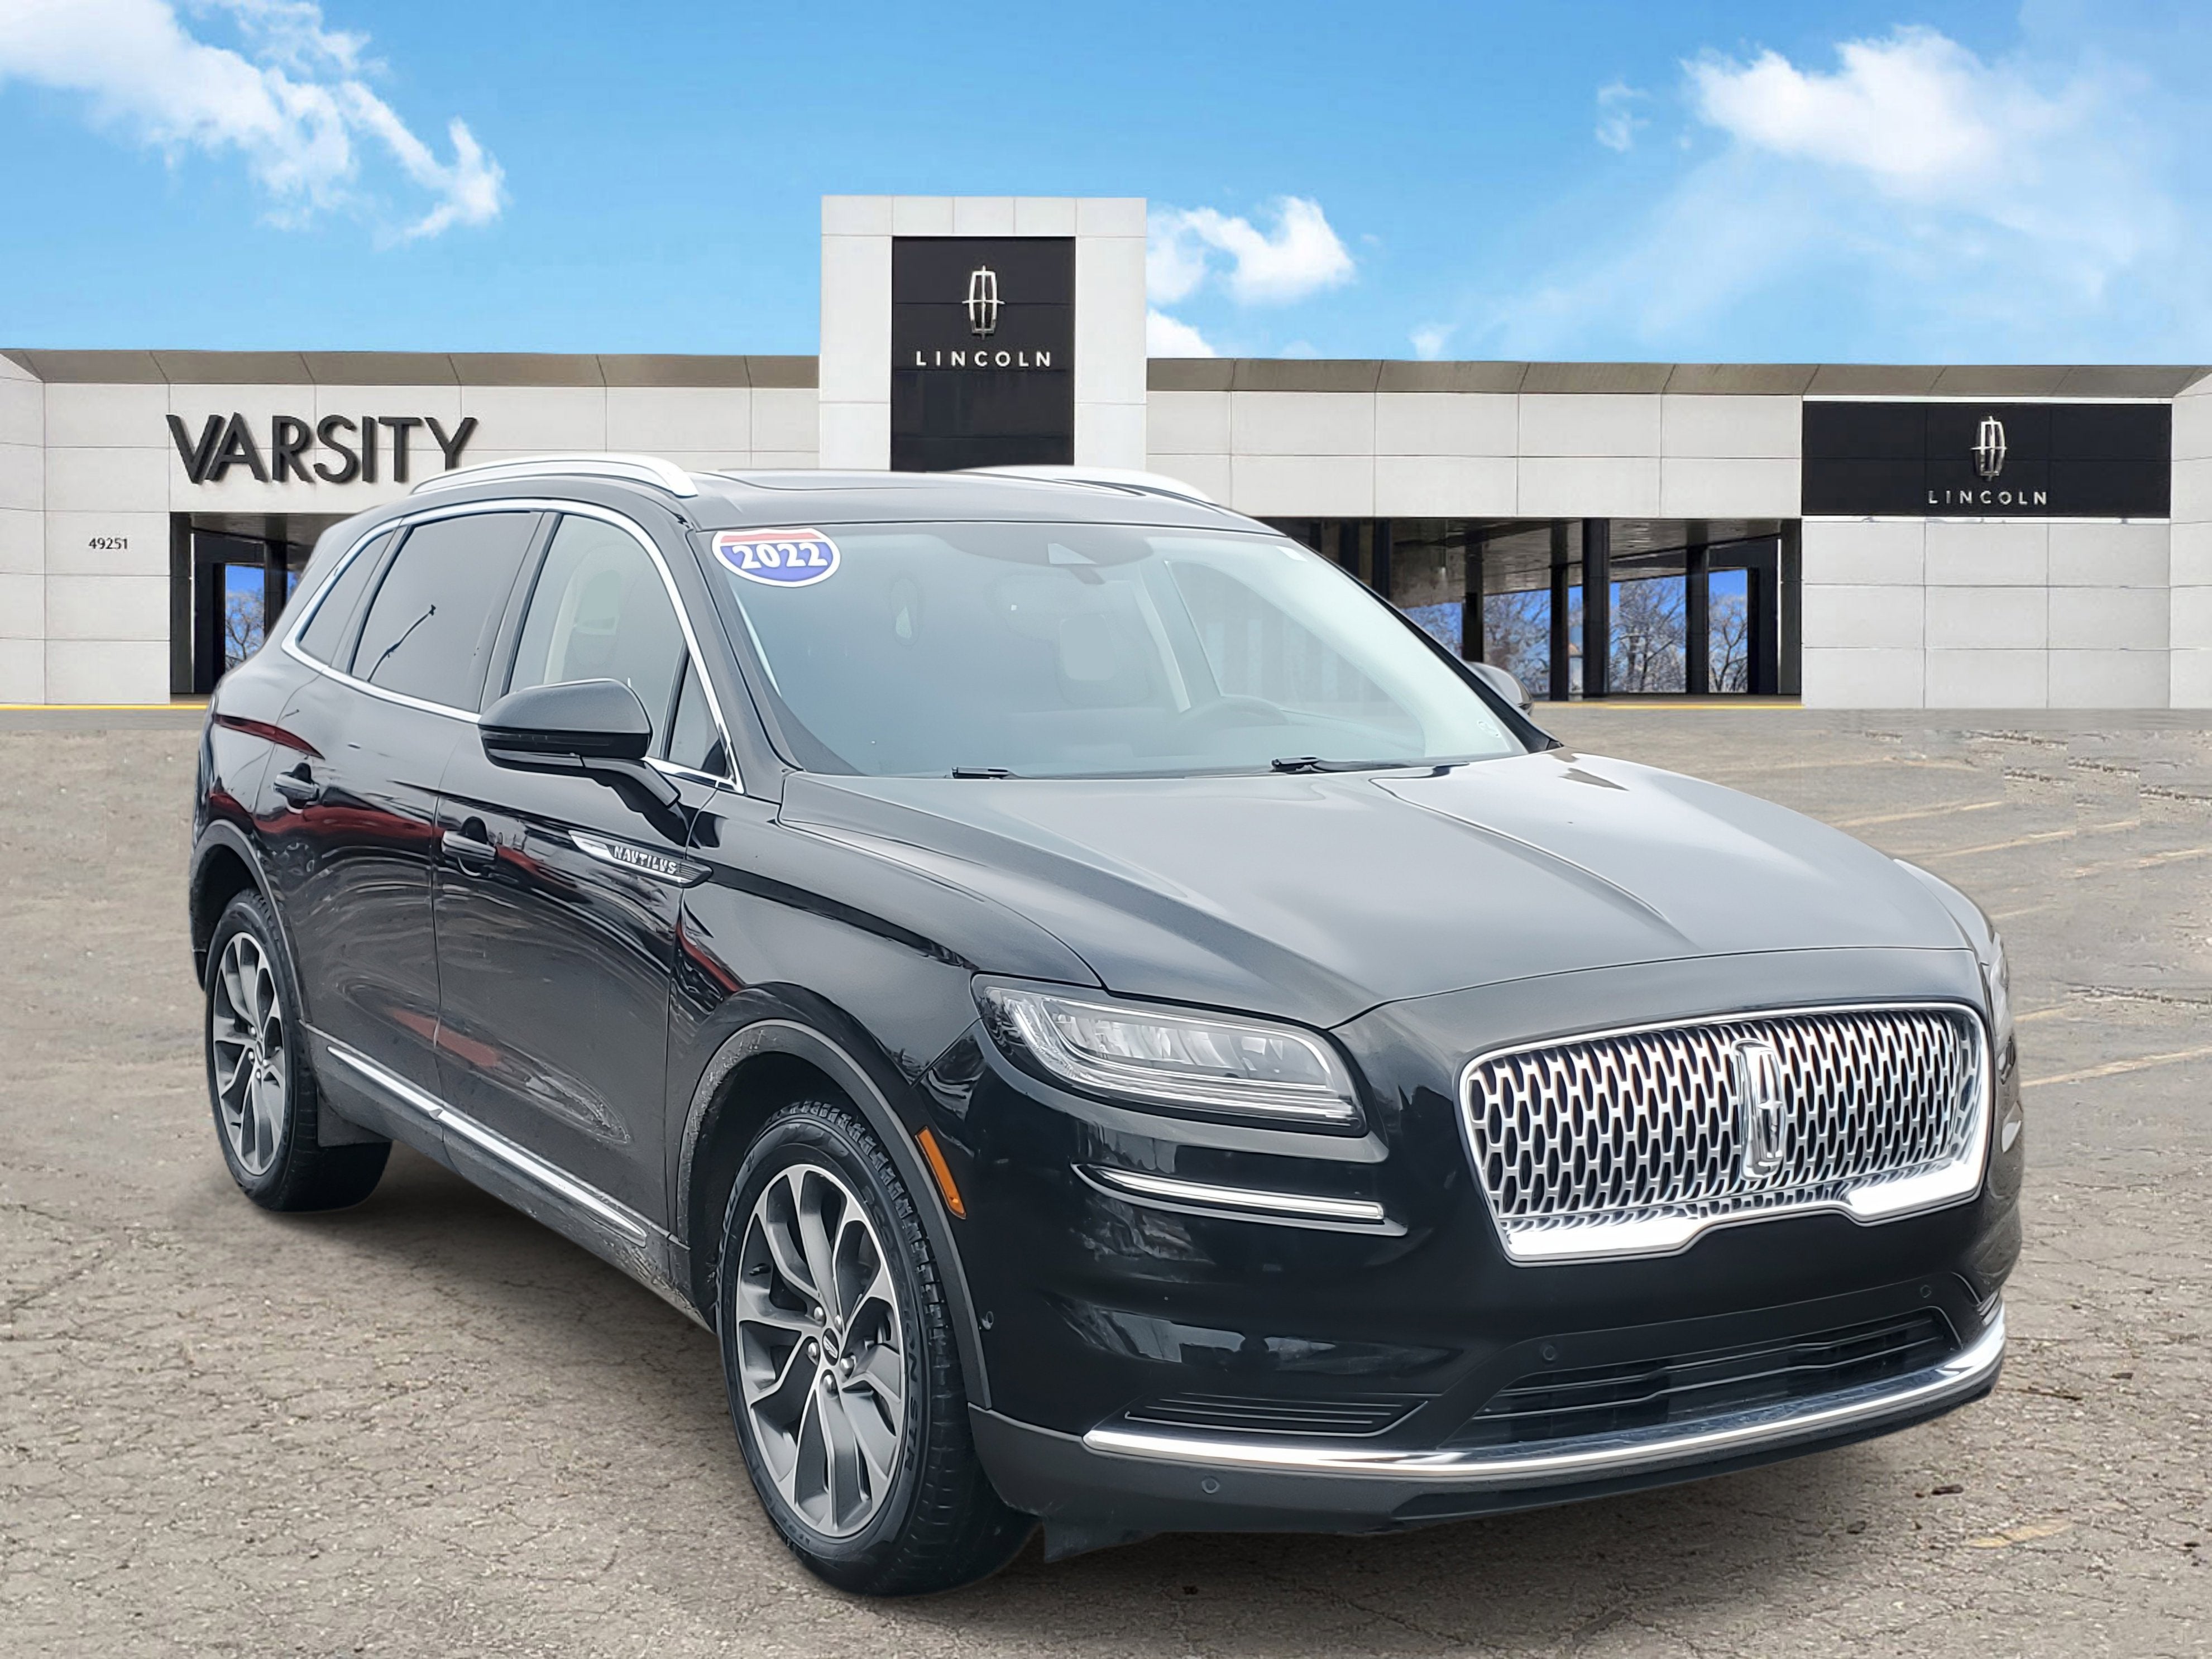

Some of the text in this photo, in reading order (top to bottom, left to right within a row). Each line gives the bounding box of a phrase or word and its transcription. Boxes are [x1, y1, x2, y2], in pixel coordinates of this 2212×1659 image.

[916, 351, 1051, 367] LINCOLN
[166, 412, 478, 484] VARSITY
[1928, 490, 2047, 505] LINCOLN
[88, 537, 128, 549] 49251
[732, 542, 828, 569] 2022
[614, 846, 677, 874] NAUTILUS
